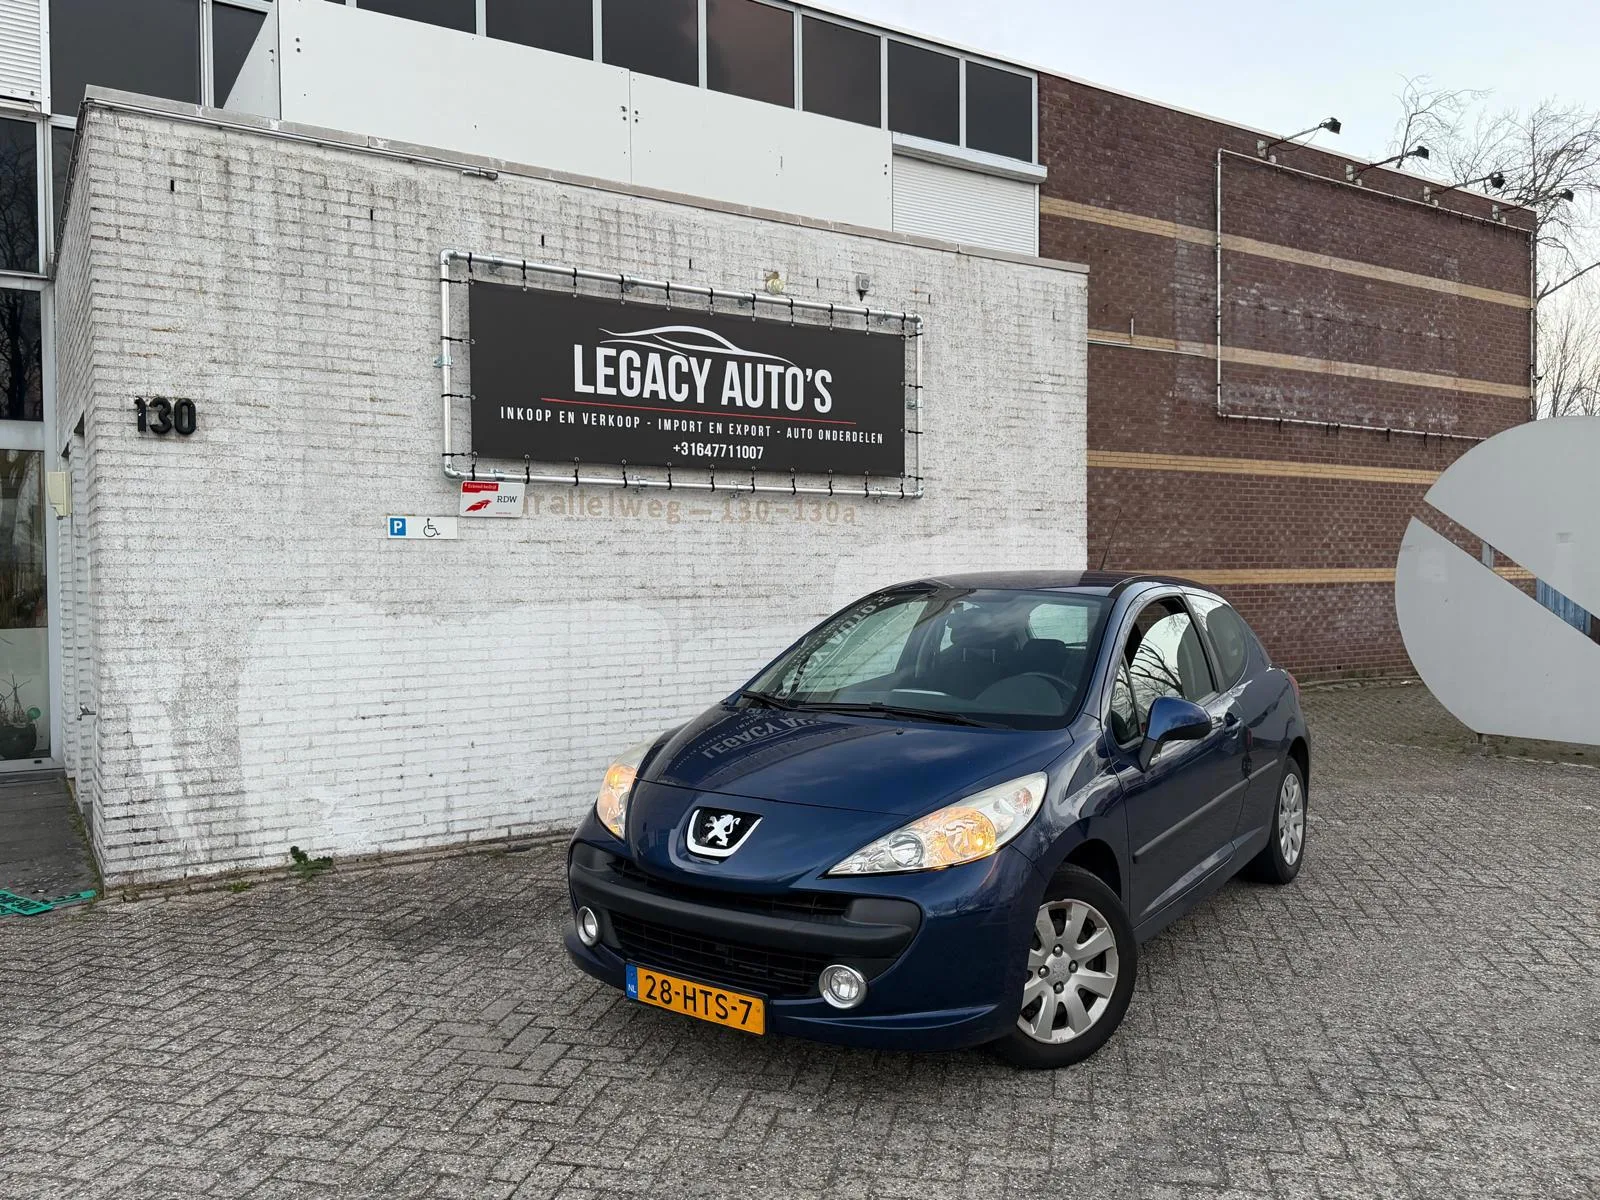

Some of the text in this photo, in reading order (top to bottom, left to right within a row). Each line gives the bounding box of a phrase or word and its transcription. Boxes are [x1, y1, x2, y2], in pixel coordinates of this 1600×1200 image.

[574, 344, 833, 414] LEGACY AUTO'S
[134, 395, 197, 435] 130
[500, 406, 552, 422] INKOOP
[559, 411, 576, 425] EN
[582, 412, 641, 429] VERKOOP
[658, 418, 703, 434] IMPORT
[709, 422, 723, 435] EN
[728, 423, 771, 438] EXPORT
[786, 427, 813, 440] AUTO
[818, 429, 884, 445] ONDERDELEN
[672, 441, 764, 460] +31647711007
[496, 495, 518, 504] RDW
[392, 520, 403, 534] P
[627, 983, 637, 993] NL
[645, 975, 753, 1025] 28-HTS-7
